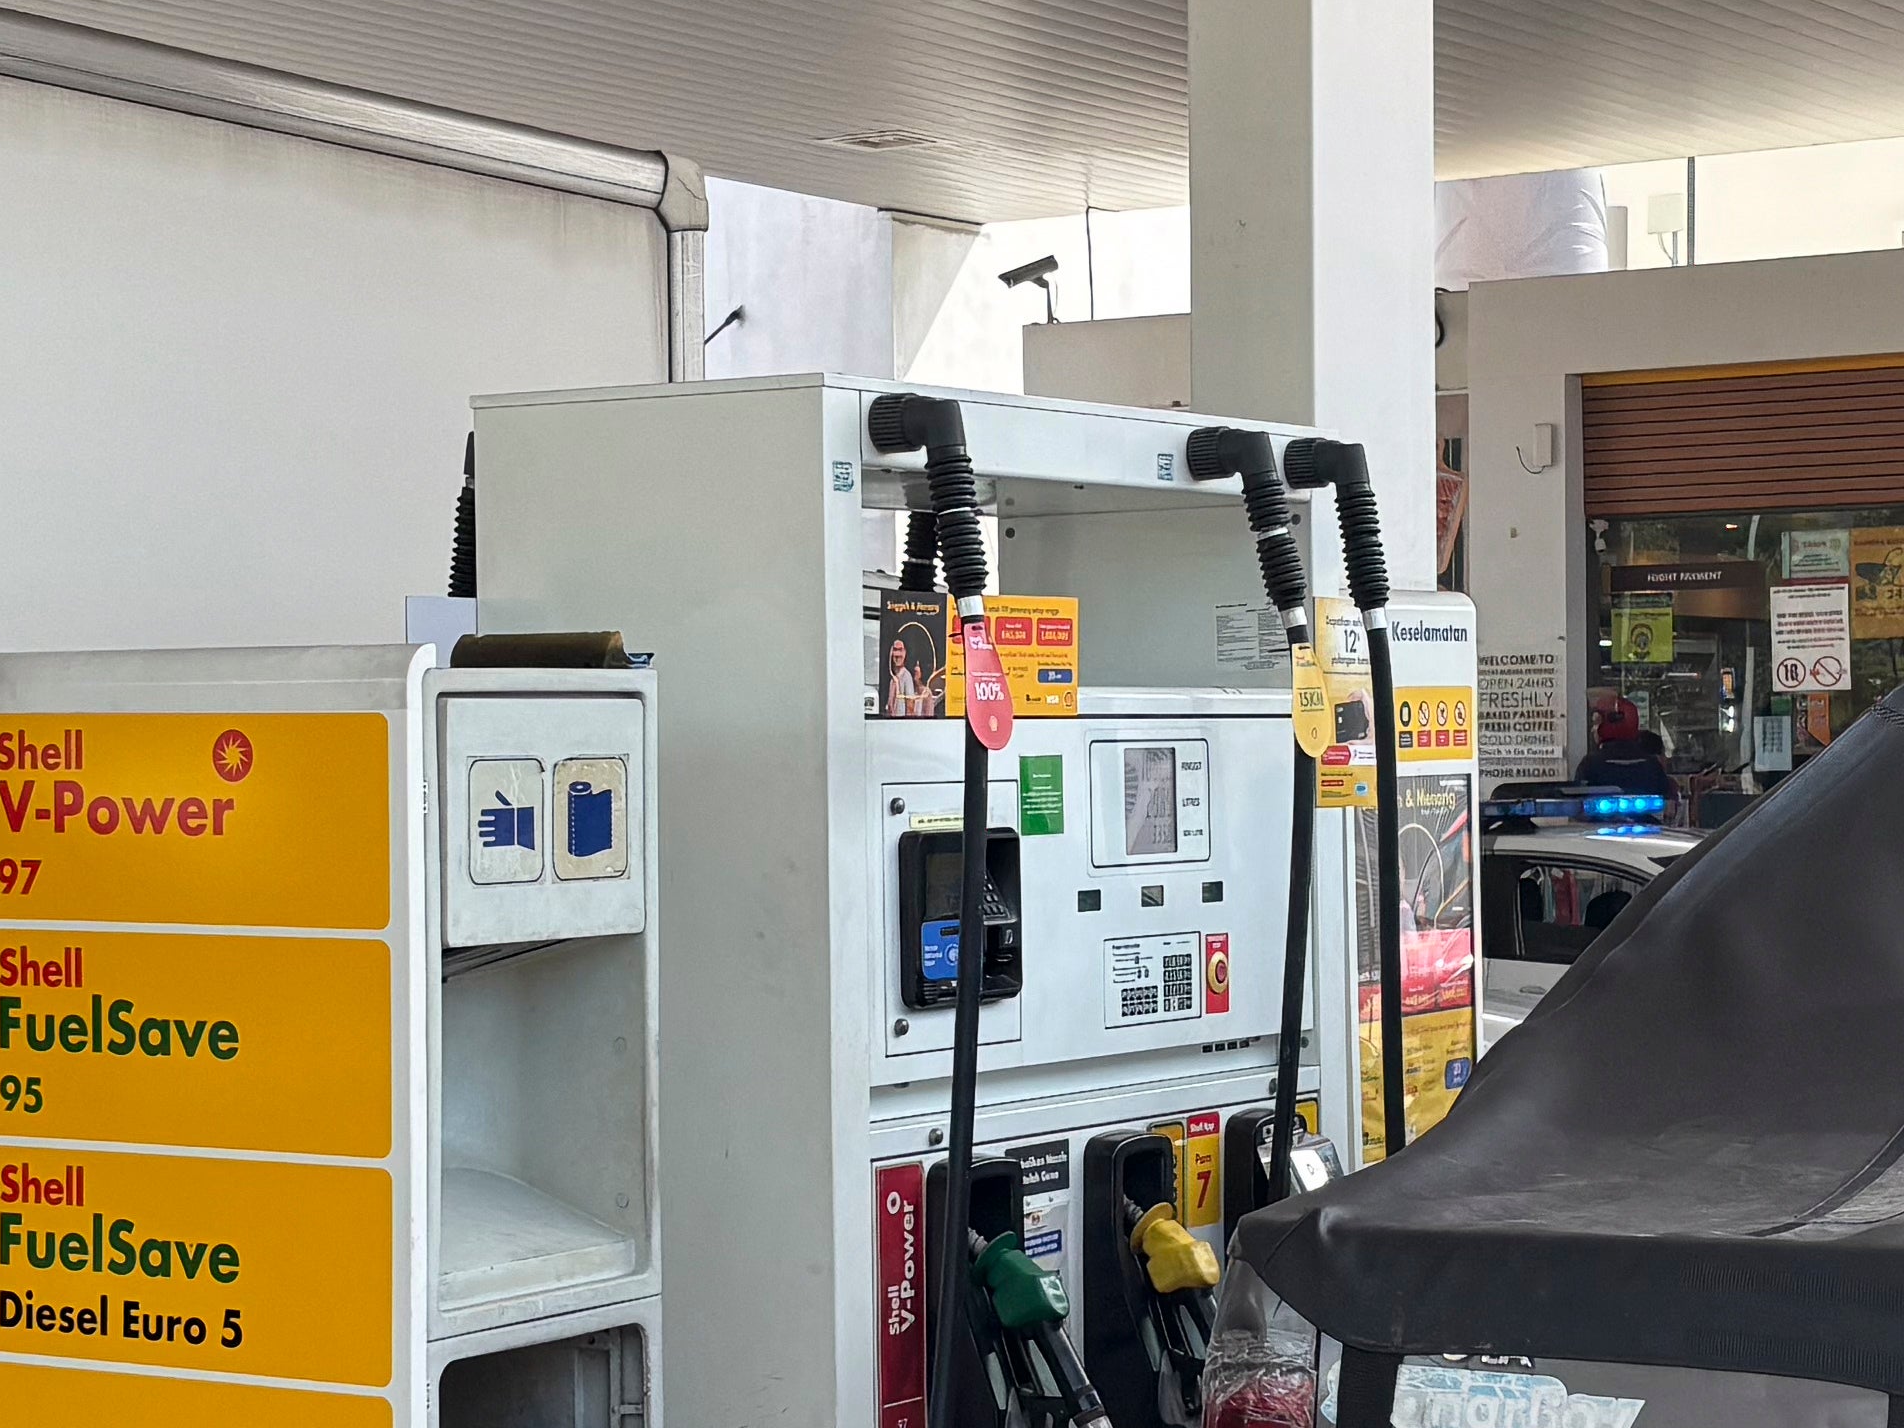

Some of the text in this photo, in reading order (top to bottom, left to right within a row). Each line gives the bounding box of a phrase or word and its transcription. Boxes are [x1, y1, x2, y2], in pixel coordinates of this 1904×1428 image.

[1392, 620, 1468, 642] Keselamatan
[1479, 692, 1554, 708] FRESHLY
[1406, 791, 1414, 807] &
[0, 1075, 43, 1114] 95
[0, 1164, 85, 1207] Shell
[1197, 1170, 1212, 1209] 7
[900, 1200, 916, 1333] V-Power
[123, 1299, 207, 1346] Euro
[220, 1308, 243, 1348] 5
[889, 1285, 901, 1336] Shell
